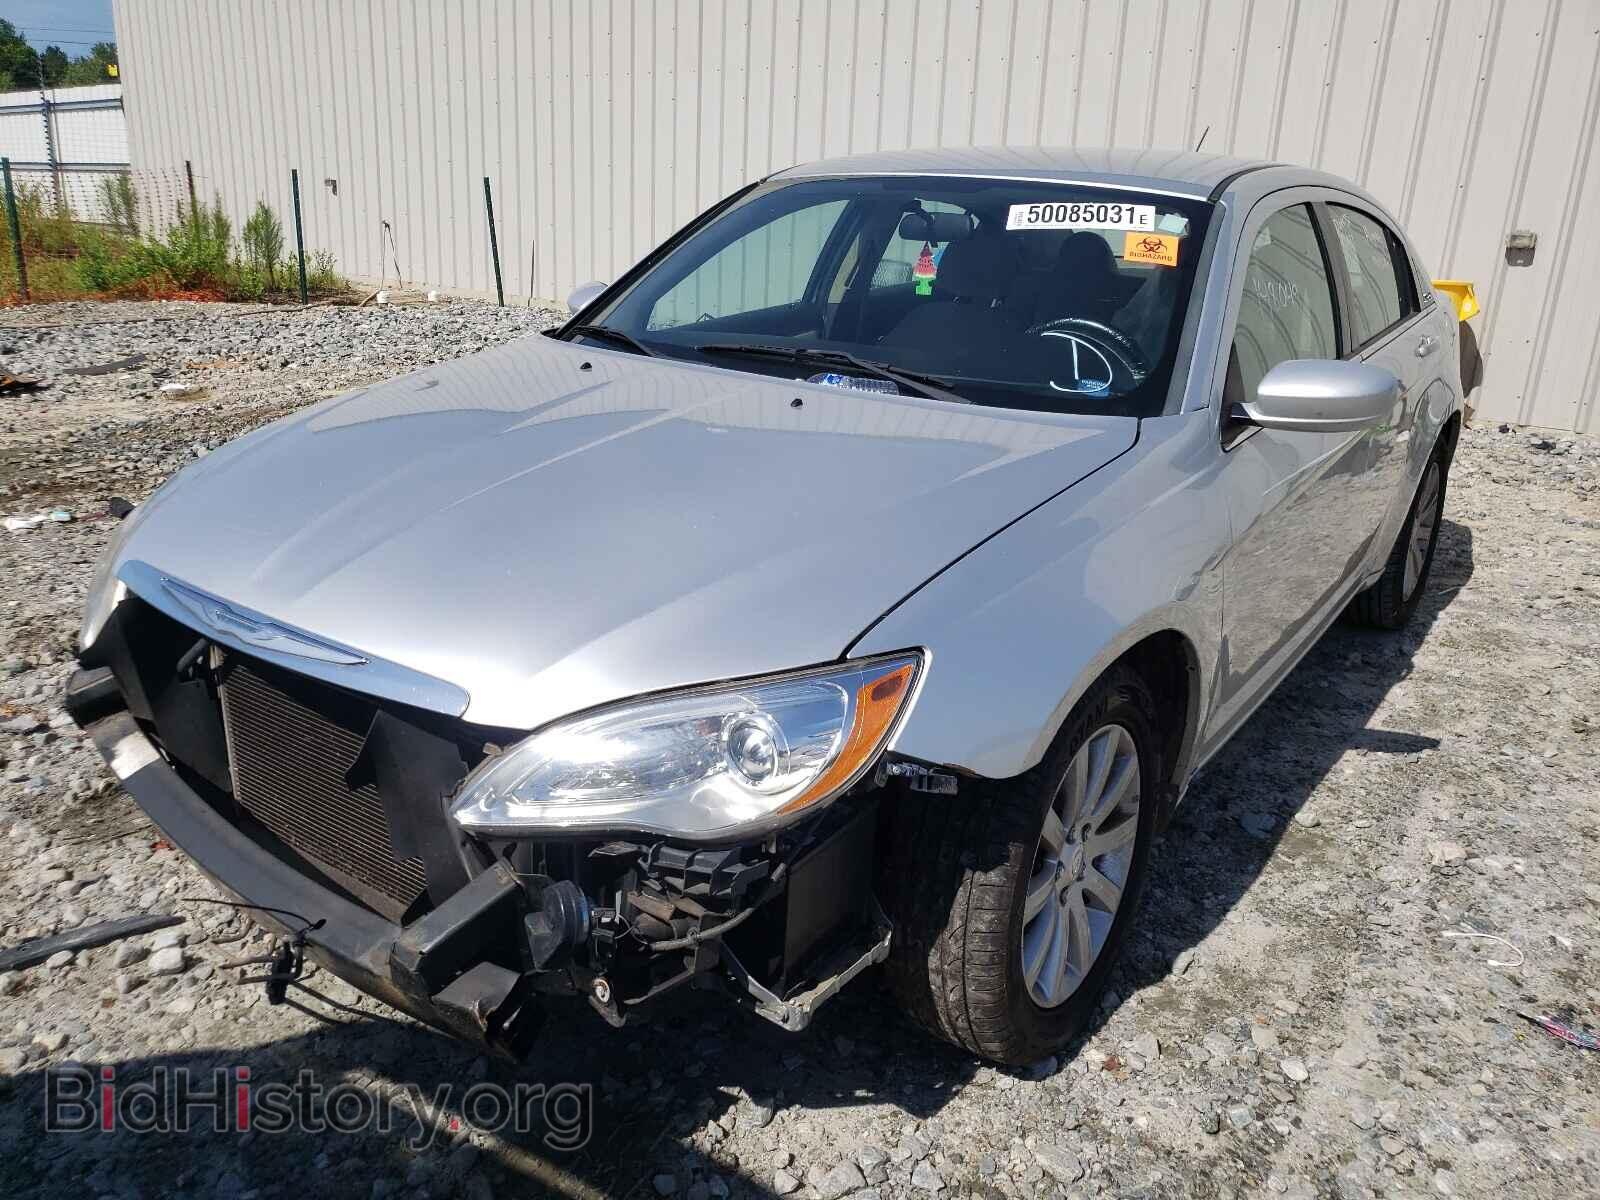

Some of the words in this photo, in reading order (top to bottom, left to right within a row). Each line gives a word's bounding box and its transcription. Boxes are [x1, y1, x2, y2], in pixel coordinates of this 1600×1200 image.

[1027, 204, 1135, 224] 50085031
[1139, 214, 1148, 225] E
[1129, 250, 1173, 262] BIOHAZARD
